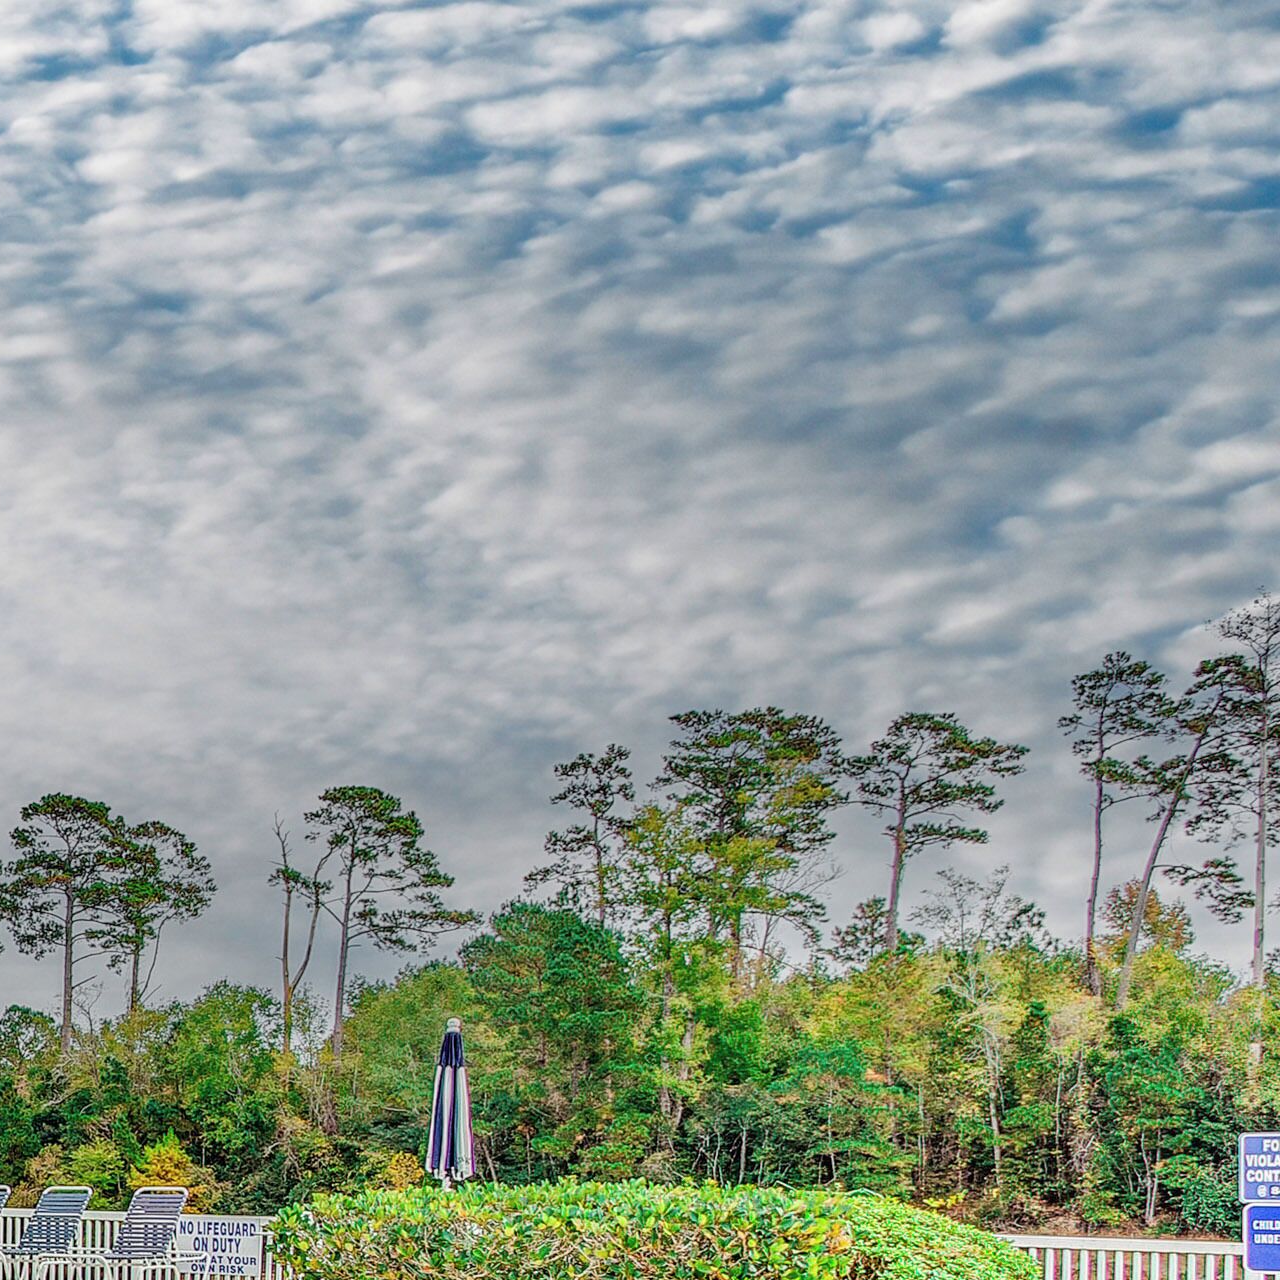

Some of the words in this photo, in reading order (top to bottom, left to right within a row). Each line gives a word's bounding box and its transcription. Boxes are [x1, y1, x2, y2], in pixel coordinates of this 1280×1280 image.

[1246, 1169, 1280, 1182] CONT
[180, 1221, 194, 1234] NO
[197, 1222, 256, 1236] LIFEGUARD
[193, 1237, 208, 1251] ON
[212, 1239, 241, 1253] DUTY
[227, 1256, 257, 1265] YOUR
[191, 1264, 215, 1272] OWN
[219, 1265, 244, 1274] RISK
